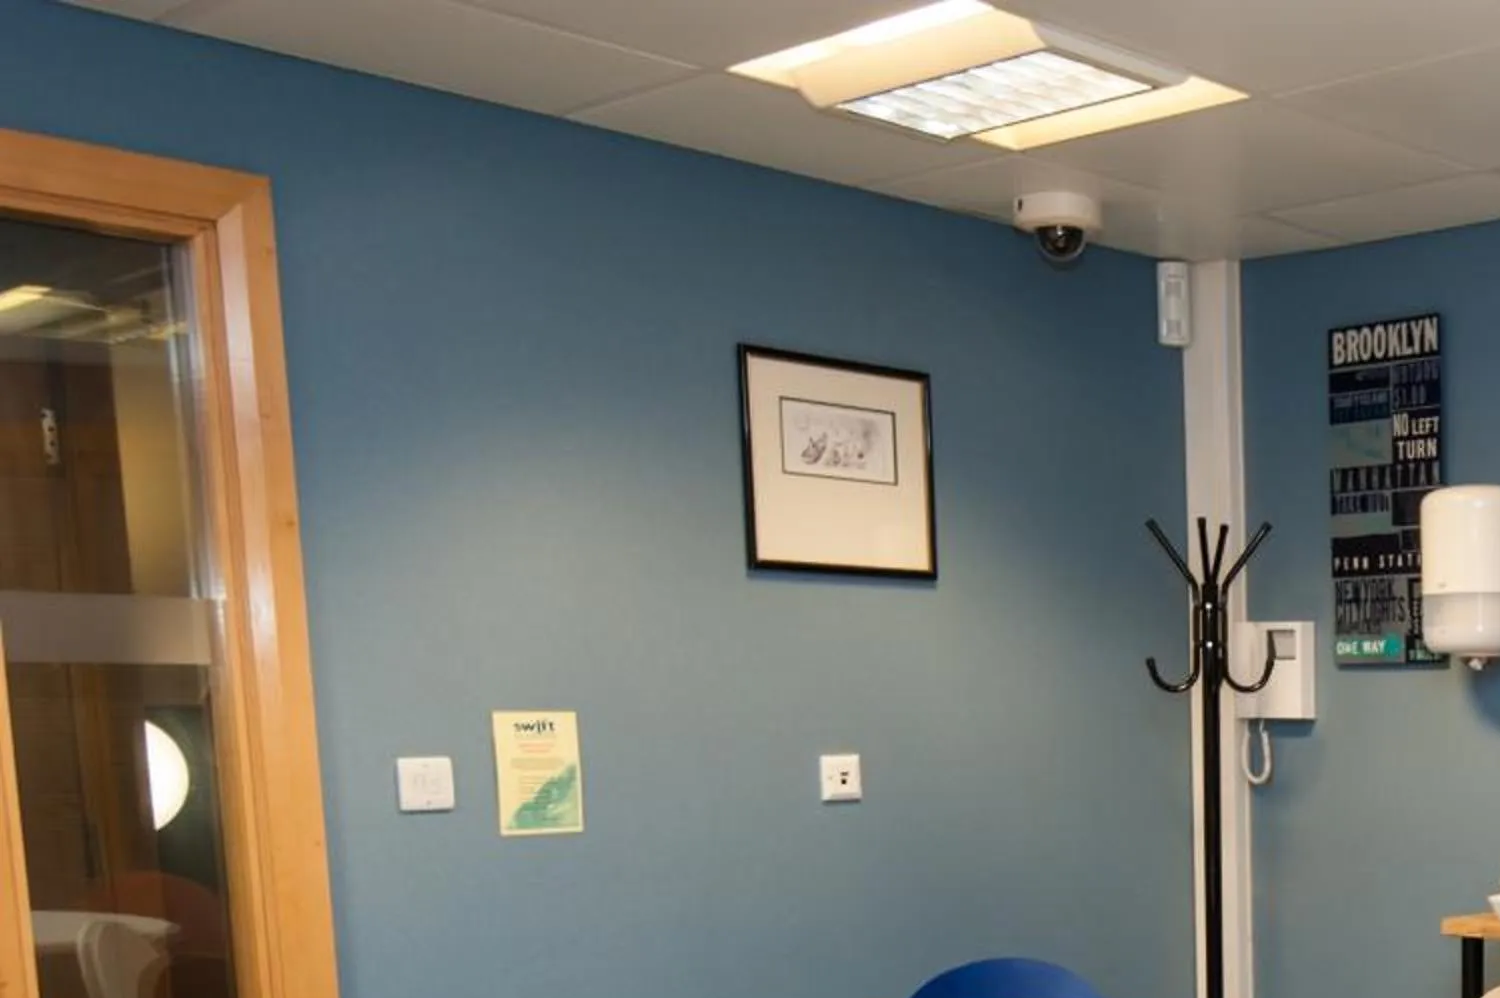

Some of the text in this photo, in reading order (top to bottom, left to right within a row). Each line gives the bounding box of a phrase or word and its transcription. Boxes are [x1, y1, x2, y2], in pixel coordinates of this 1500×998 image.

[1332, 317, 1438, 365] BROOKLYN
[1393, 413, 1410, 437] NO
[1411, 417, 1440, 435] LEFT
[1397, 439, 1438, 460] TURN
[1334, 556, 1369, 571] PENN
[1336, 639, 1387, 655] ONE WAY
[513, 720, 555, 733] swift
